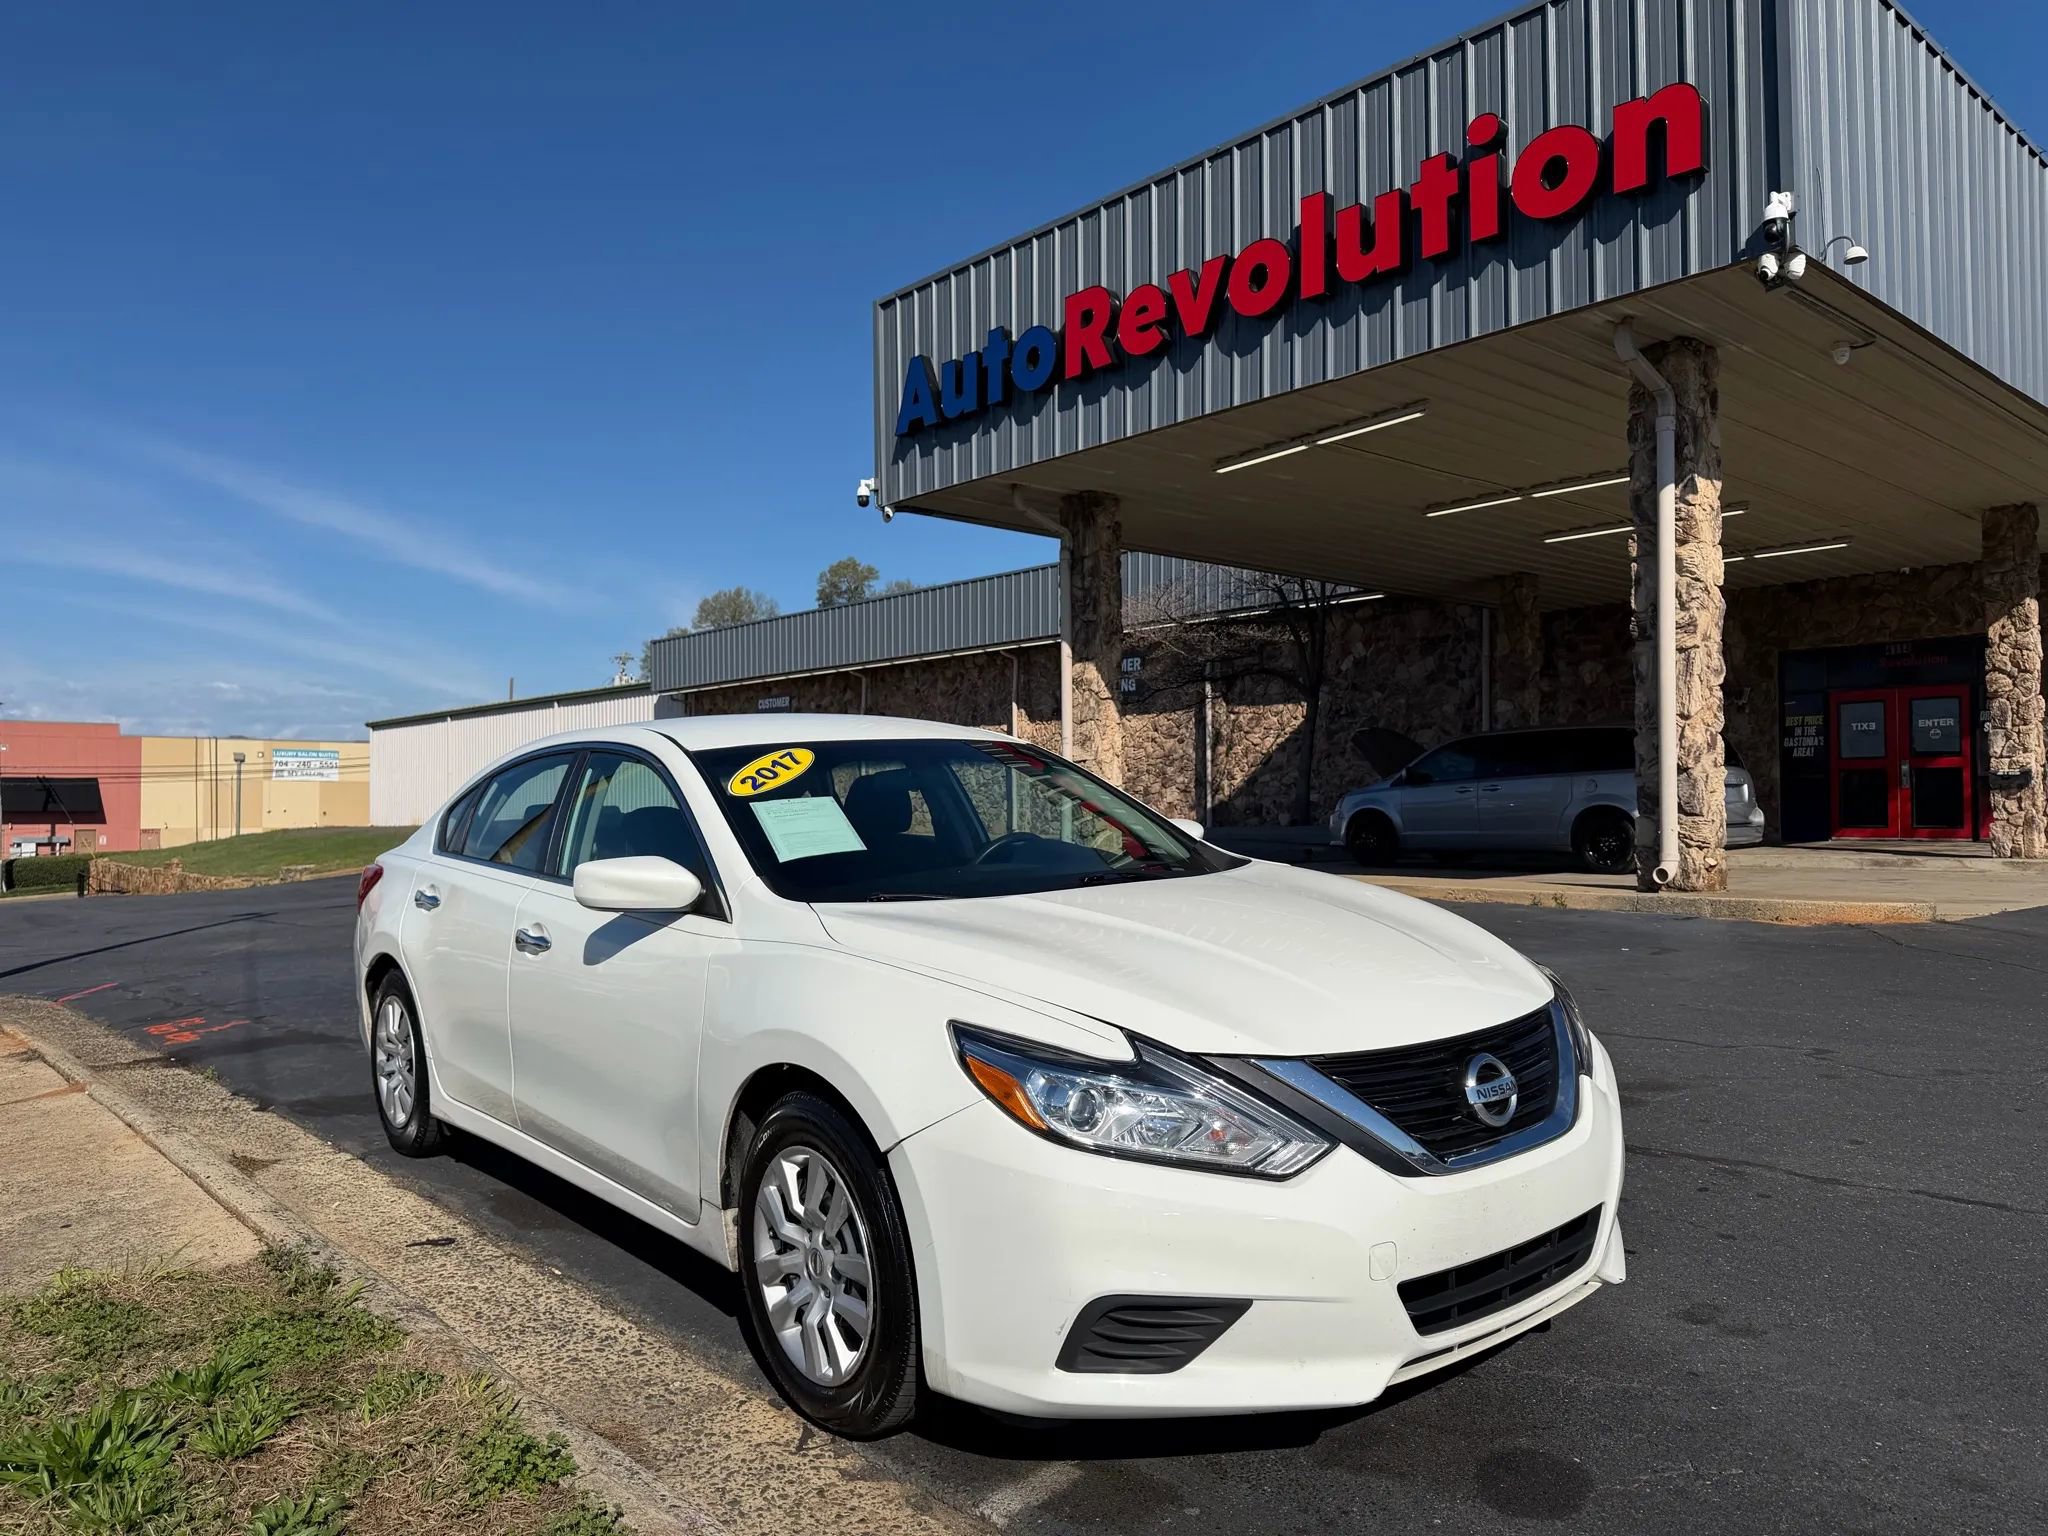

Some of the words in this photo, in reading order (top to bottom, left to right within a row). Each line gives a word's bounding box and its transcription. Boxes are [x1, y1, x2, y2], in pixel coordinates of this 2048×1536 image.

[758, 696, 790, 709] CUSTOMER
[1918, 718, 1954, 728] ENTER
[1803, 725, 1817, 736] THE
[273, 750, 297, 758] LUXURY
[318, 751, 339, 759] SUITES
[739, 751, 802, 791] 2017
[1476, 1079, 1517, 1100] NISSAN
